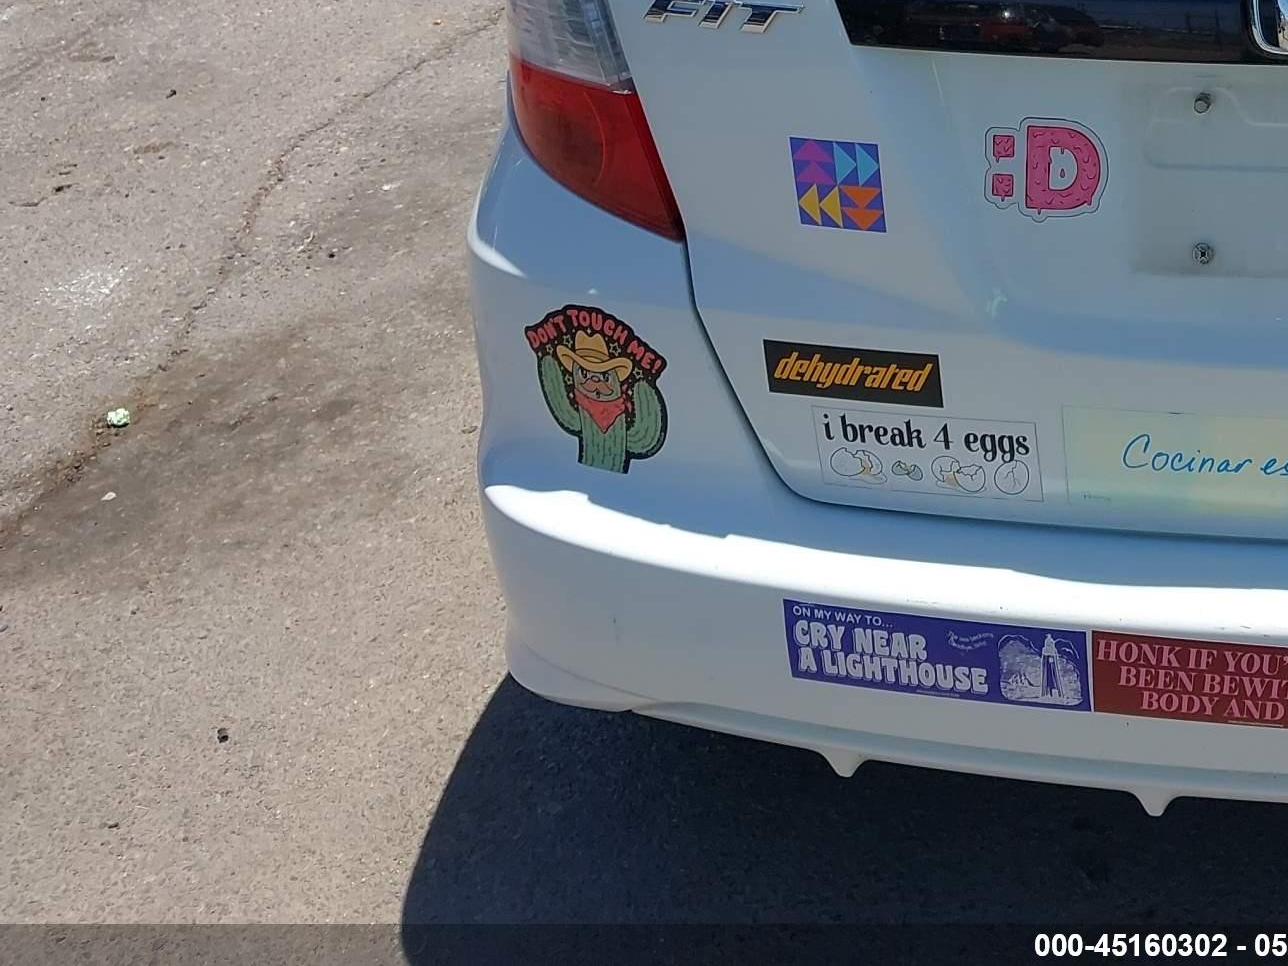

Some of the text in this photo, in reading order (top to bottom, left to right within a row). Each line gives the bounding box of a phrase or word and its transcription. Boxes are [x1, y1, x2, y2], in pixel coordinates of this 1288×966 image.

[527, 309, 663, 374] DON'T TOUCH ME!
[773, 351, 934, 392] dehydrated
[823, 413, 1031, 464] i break 4 eggs
[1122, 434, 1253, 475] Cocinar
[793, 606, 893, 628] ON MY WAY TO...
[794, 619, 846, 652] CRY
[852, 627, 928, 662] NEAR
[1095, 638, 1183, 668] HONK
[1187, 647, 1218, 670] IF
[799, 647, 990, 695] A LIGHTHOUSE
[1118, 666, 1196, 691] BEEN
[1140, 691, 1220, 716] BODY
[1223, 696, 1286, 722] AND
